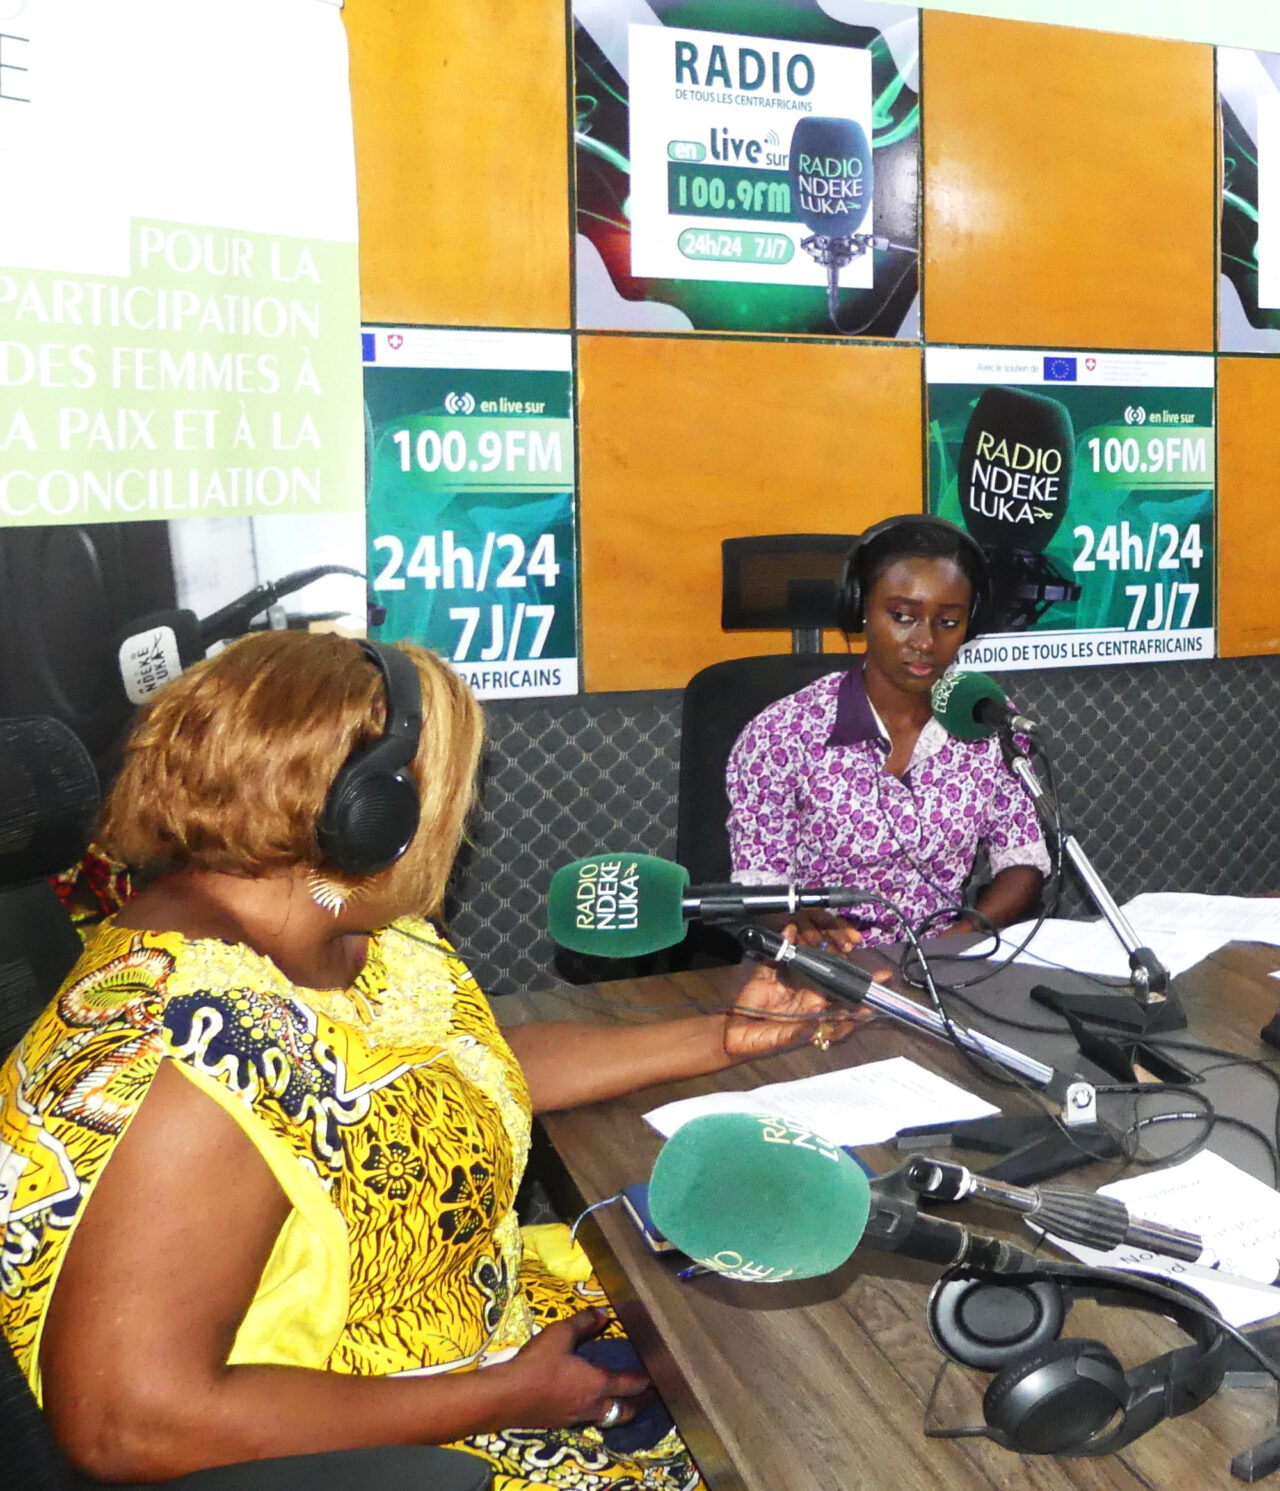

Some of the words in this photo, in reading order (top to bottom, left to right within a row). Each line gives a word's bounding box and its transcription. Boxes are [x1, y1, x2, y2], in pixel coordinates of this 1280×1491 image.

[675, 40, 815, 97] RADIO
[675, 88, 688, 100] DE
[690, 90, 715, 103] TOUS
[717, 93, 733, 105] LES
[735, 94, 813, 113] CENTRAFRICAINS
[675, 142, 697, 160] en
[766, 152, 789, 167] sur
[799, 153, 863, 178] RADIO
[798, 174, 864, 198] NDEKE
[800, 193, 848, 214] LUKA
[138, 225, 255, 280] POUR
[270, 242, 321, 285] LA
[683, 232, 743, 257] 24h/24
[0, 273, 321, 340] PARTICIPATION
[0, 340, 97, 390] DES
[111, 346, 281, 394] FEMMES
[294, 345, 323, 395] À
[1, 407, 38, 452] A
[59, 407, 158, 451] PAIX
[173, 408, 222, 451] ET
[232, 399, 256, 450] À
[271, 411, 323, 451] LA
[480, 401, 497, 413] en
[499, 398, 523, 414] live
[524, 400, 545, 415] sur
[1149, 412, 1161, 424] en
[1162, 410, 1179, 424] live
[1180, 413, 1195, 424] sur
[392, 429, 563, 473] 100.9FM
[975, 430, 1063, 476] RADIO
[1088, 437, 1207, 474] 100.9FM
[0, 466, 321, 518] CONCILIATION
[971, 459, 1060, 501] NDEKE
[969, 486, 1036, 525] LUKA
[372, 530, 560, 592] 24h/24
[1072, 521, 1204, 573] 24h/24
[1124, 581, 1200, 632] 7J/7
[449, 602, 556, 662] 7J/7
[964, 646, 1008, 665] RADIO
[1012, 645, 1031, 661] DE
[1032, 642, 1067, 660] TOUS
[1071, 641, 1093, 658] LES
[1096, 636, 1203, 657] CENTRAFRICAINS
[460, 668, 561, 690] AFRICAINS
[576, 863, 600, 930] RADIO
[596, 860, 622, 931] NDEKE
[618, 874, 640, 929] LUKA
